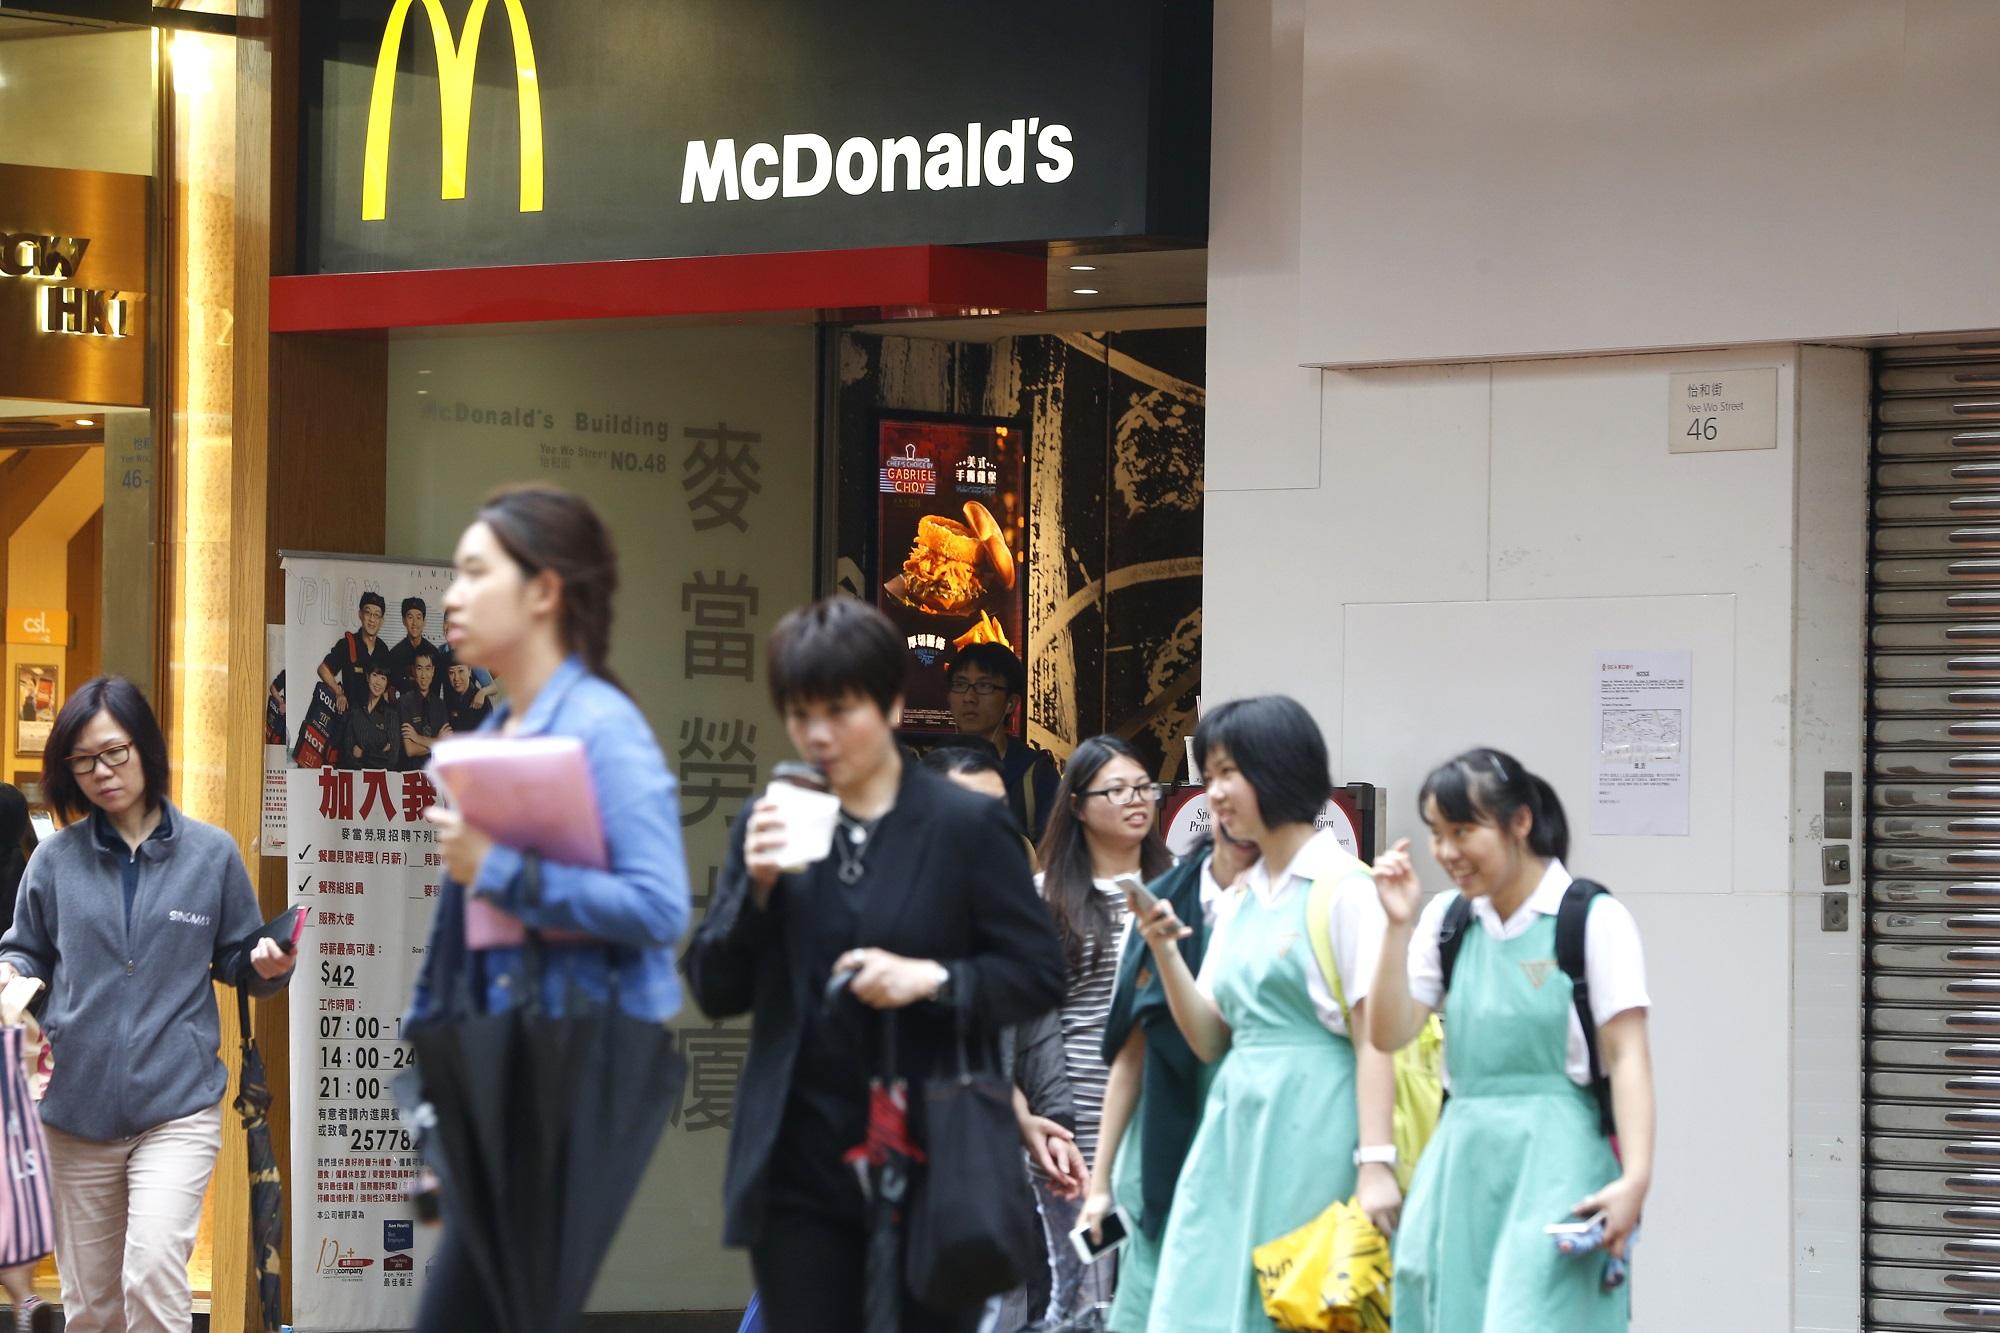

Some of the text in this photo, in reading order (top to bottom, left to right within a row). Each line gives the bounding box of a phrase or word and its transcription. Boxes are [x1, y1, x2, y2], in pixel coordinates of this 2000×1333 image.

[680, 117, 1075, 205] McDonald's
[0, 232, 90, 279] CW
[45, 285, 147, 338] HKT
[1687, 383, 1722, 398] 怡和街
[1687, 401, 1745, 413] Yee Wo Street
[420, 402, 670, 443] McDonald's Building
[1686, 417, 1718, 441] 46
[560, 445, 575, 457] Wo
[577, 446, 608, 459] Street
[610, 449, 667, 473] NO.48
[887, 467, 934, 481] GABRIEL
[906, 461, 926, 469] CHOICE
[895, 481, 925, 494] CHOY
[304, 730, 325, 753] HOT
[318, 767, 438, 823] 加入我
[1313, 817, 1334, 829] otion
[423, 852, 442, 866] 見習
[318, 911, 355, 926] 服務大使
[320, 960, 355, 987] $42
[321, 1046, 416, 1069] 14:00-24
[319, 1076, 390, 1100] 21:00-
[318, 1108, 400, 1122] 有意者請內進與餐
